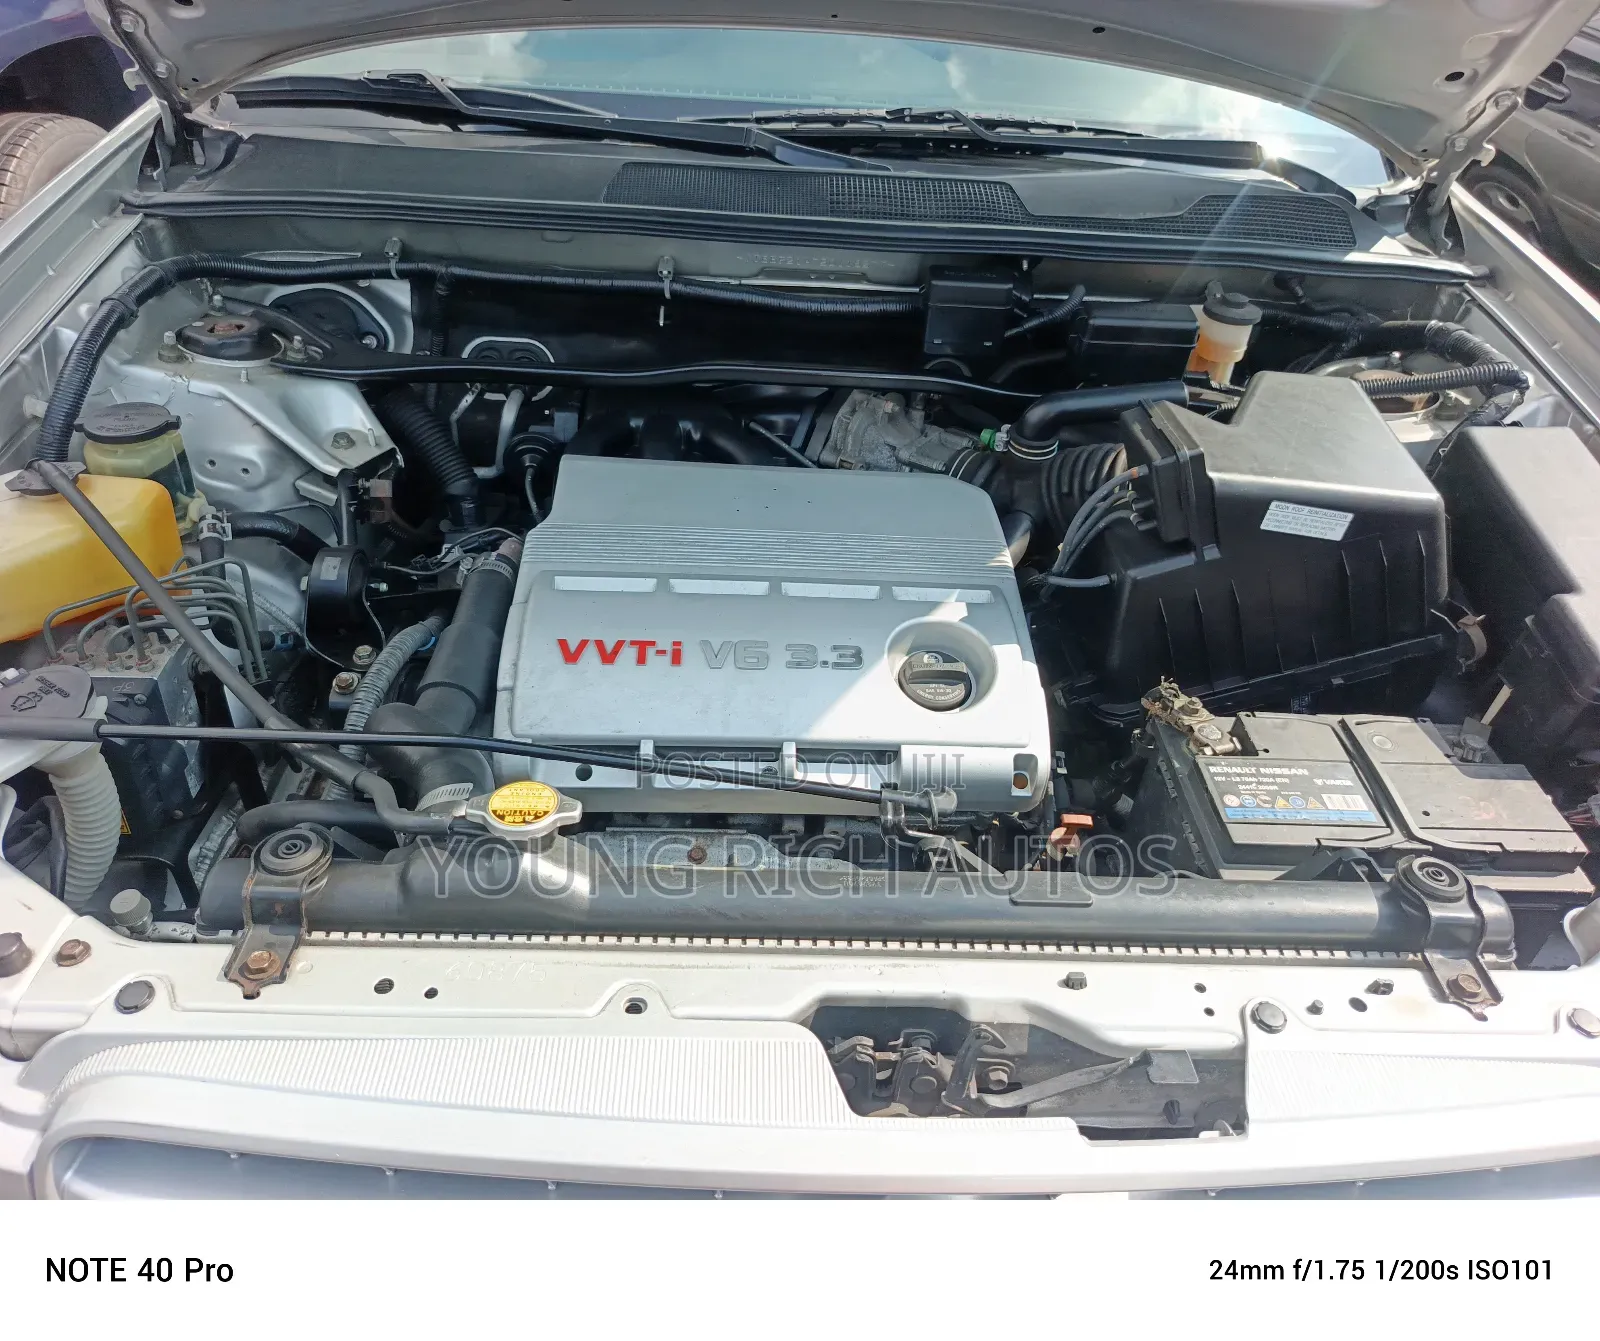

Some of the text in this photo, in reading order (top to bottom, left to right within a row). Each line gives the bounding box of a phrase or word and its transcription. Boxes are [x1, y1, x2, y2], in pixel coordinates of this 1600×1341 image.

[1274, 503, 1290, 512] MOON
[1291, 505, 1306, 513] ROOF
[556, 638, 864, 670] VVT-i V6 3.3
[1208, 766, 1309, 776] RENAULT NISSAN
